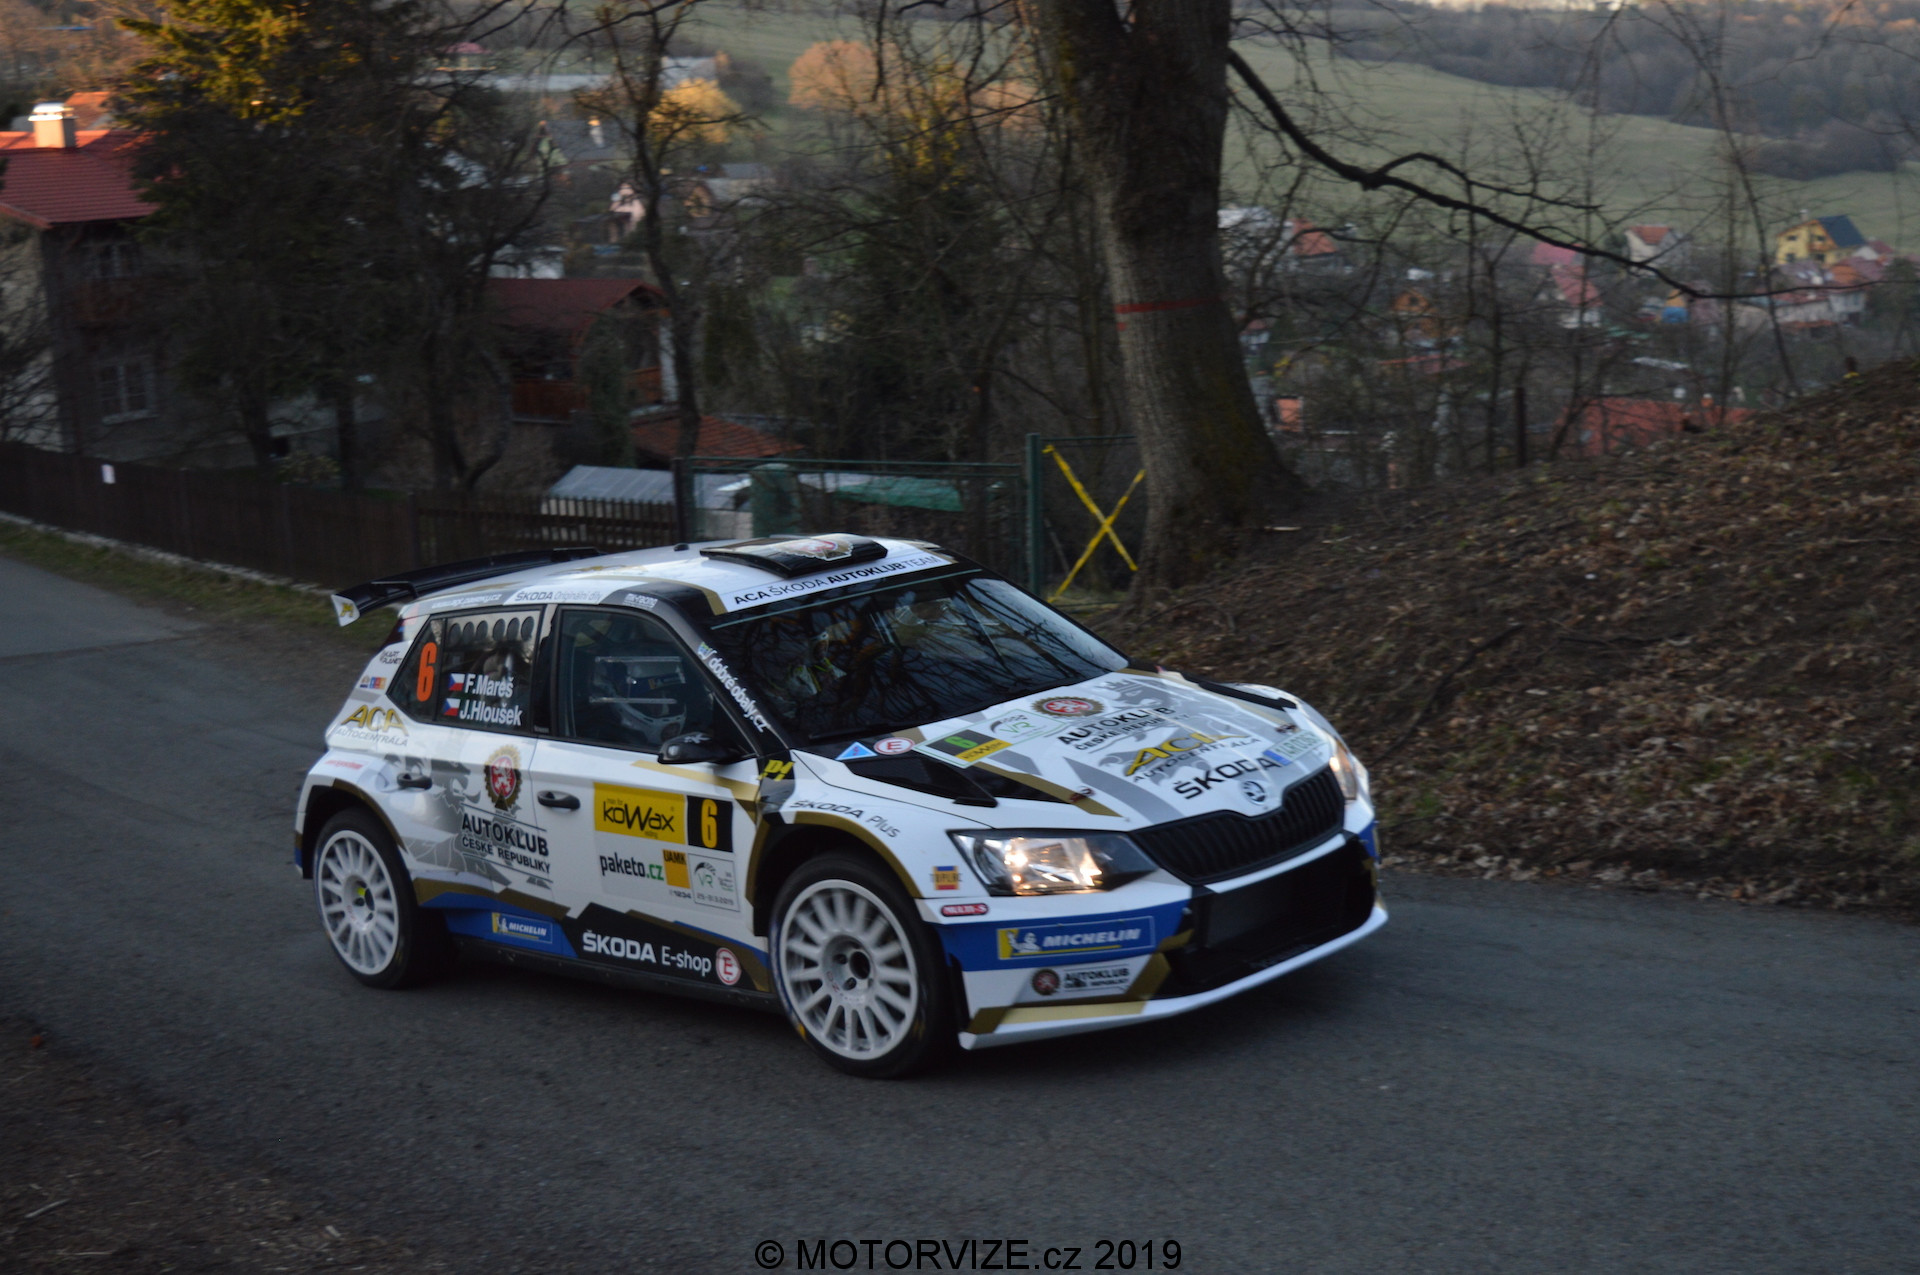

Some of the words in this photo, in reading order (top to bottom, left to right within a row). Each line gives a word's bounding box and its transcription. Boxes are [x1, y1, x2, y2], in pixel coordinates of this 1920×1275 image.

[515, 591, 554, 601] ŠKODA
[734, 591, 769, 605] ACA
[769, 578, 827, 596] ŠKODA
[827, 562, 905, 585] AUTOKLUB
[904, 556, 942, 569] TEAM
[417, 642, 437, 702] 6
[465, 673, 514, 698] F.Mareš
[341, 704, 409, 737] ACA
[459, 700, 524, 726] J.Hloušek
[1058, 707, 1176, 745] AUTOKLB
[1172, 757, 1283, 800] ŠKODA
[462, 813, 549, 857] AUTOKLUB
[701, 799, 718, 848] 6
[790, 799, 864, 819] ŠKODA
[866, 814, 901, 838] Plus
[462, 835, 494, 855] ČESKÉ
[497, 847, 551, 874] REPUBLIKY
[600, 852, 664, 881] paketo.cz
[509, 921, 548, 937] MICHELIN
[1042, 928, 1142, 948] MICHELIN
[582, 929, 656, 963] ŠKODA
[661, 946, 712, 977] E-shop
[722, 958, 734, 976] E
[1063, 968, 1130, 982] AUTOKLUB
